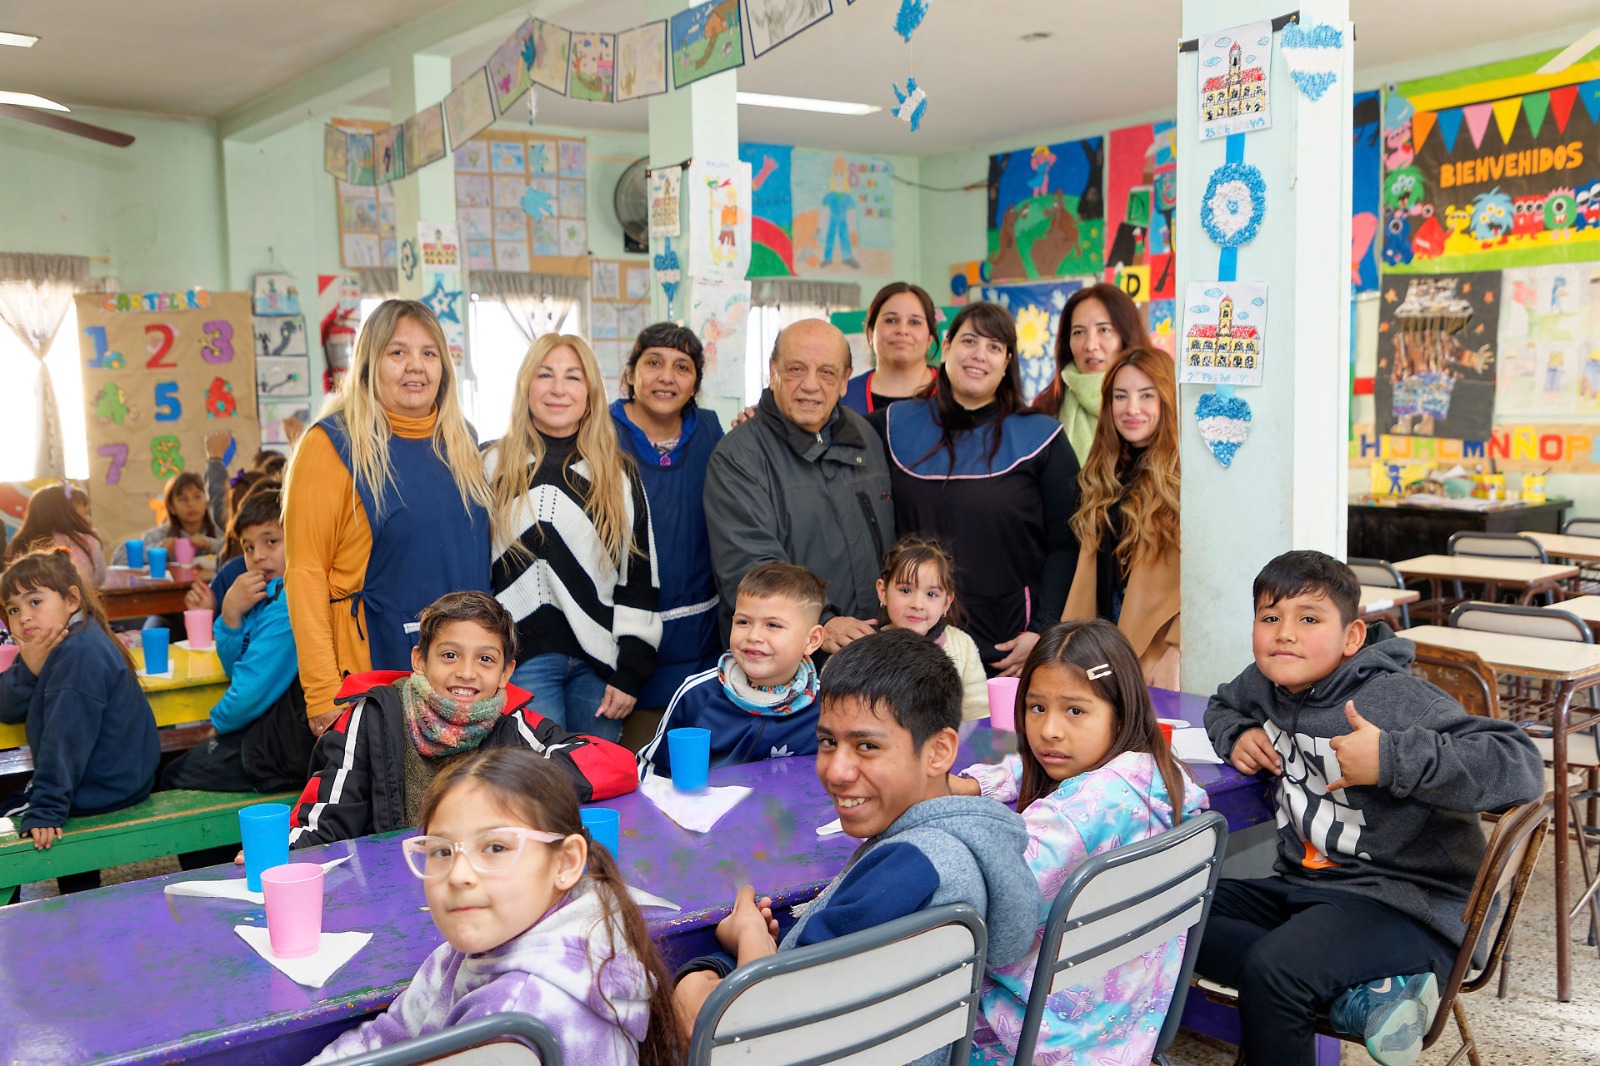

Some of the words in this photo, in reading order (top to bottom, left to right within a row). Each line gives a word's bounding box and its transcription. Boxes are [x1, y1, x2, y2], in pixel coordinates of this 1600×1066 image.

[1439, 141, 1584, 188] BIENVENIDOS
[102, 289, 211, 312] CARTELERA
[84, 325, 110, 369] 1
[144, 323, 178, 369] 2
[200, 319, 235, 365] 3
[95, 382, 128, 425] 4
[154, 381, 182, 422] 5
[205, 376, 237, 419] 6
[97, 442, 130, 485] 7
[151, 434, 185, 480] 8
